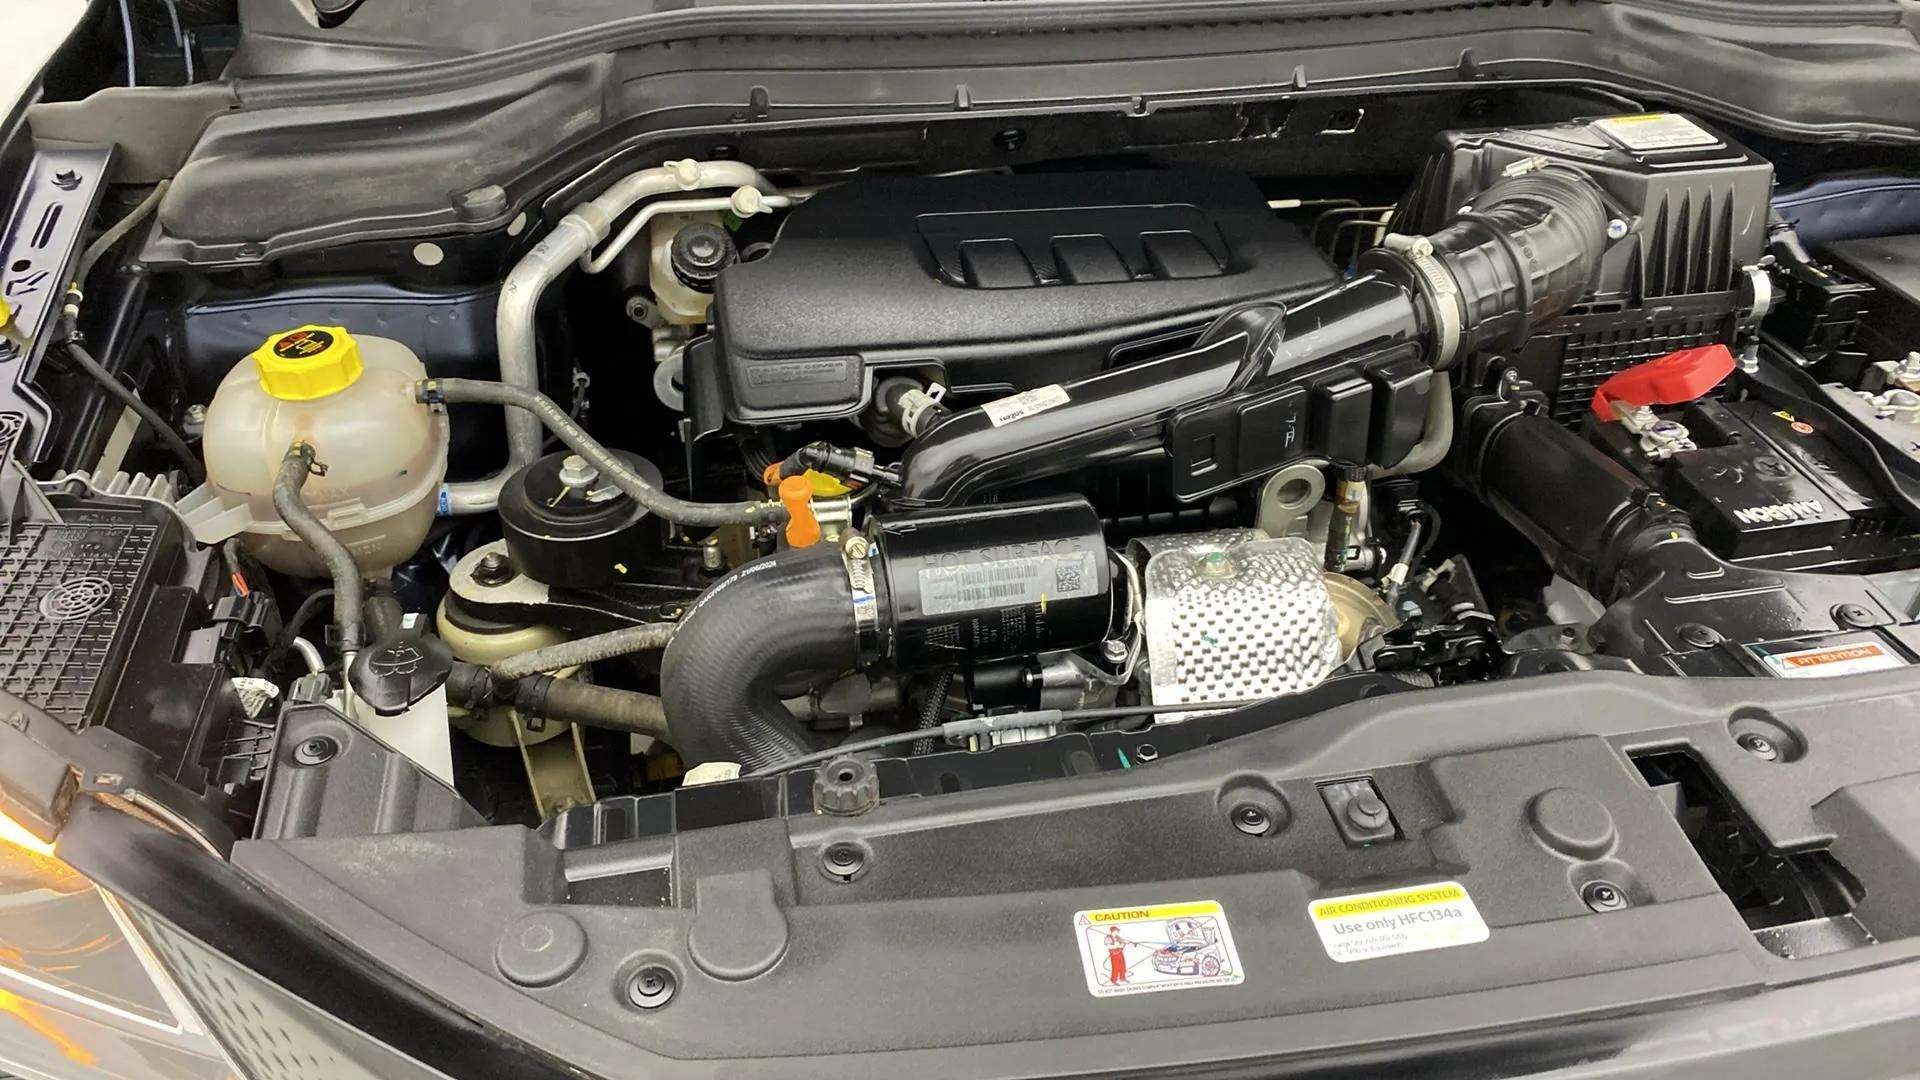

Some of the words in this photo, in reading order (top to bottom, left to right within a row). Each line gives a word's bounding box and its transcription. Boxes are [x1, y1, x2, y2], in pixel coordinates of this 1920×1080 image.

[1733, 499, 1824, 524] AMARON
[1798, 648, 1872, 665] ATTENTION
[1320, 905, 1338, 916] AIR
[1339, 895, 1416, 913] CONDITIONING
[1417, 888, 1461, 902] SYSTEM
[1094, 910, 1150, 922] CAUTION
[1333, 923, 1364, 935] Use
[1366, 917, 1397, 930] only
[1397, 907, 1464, 926] HFC134a
